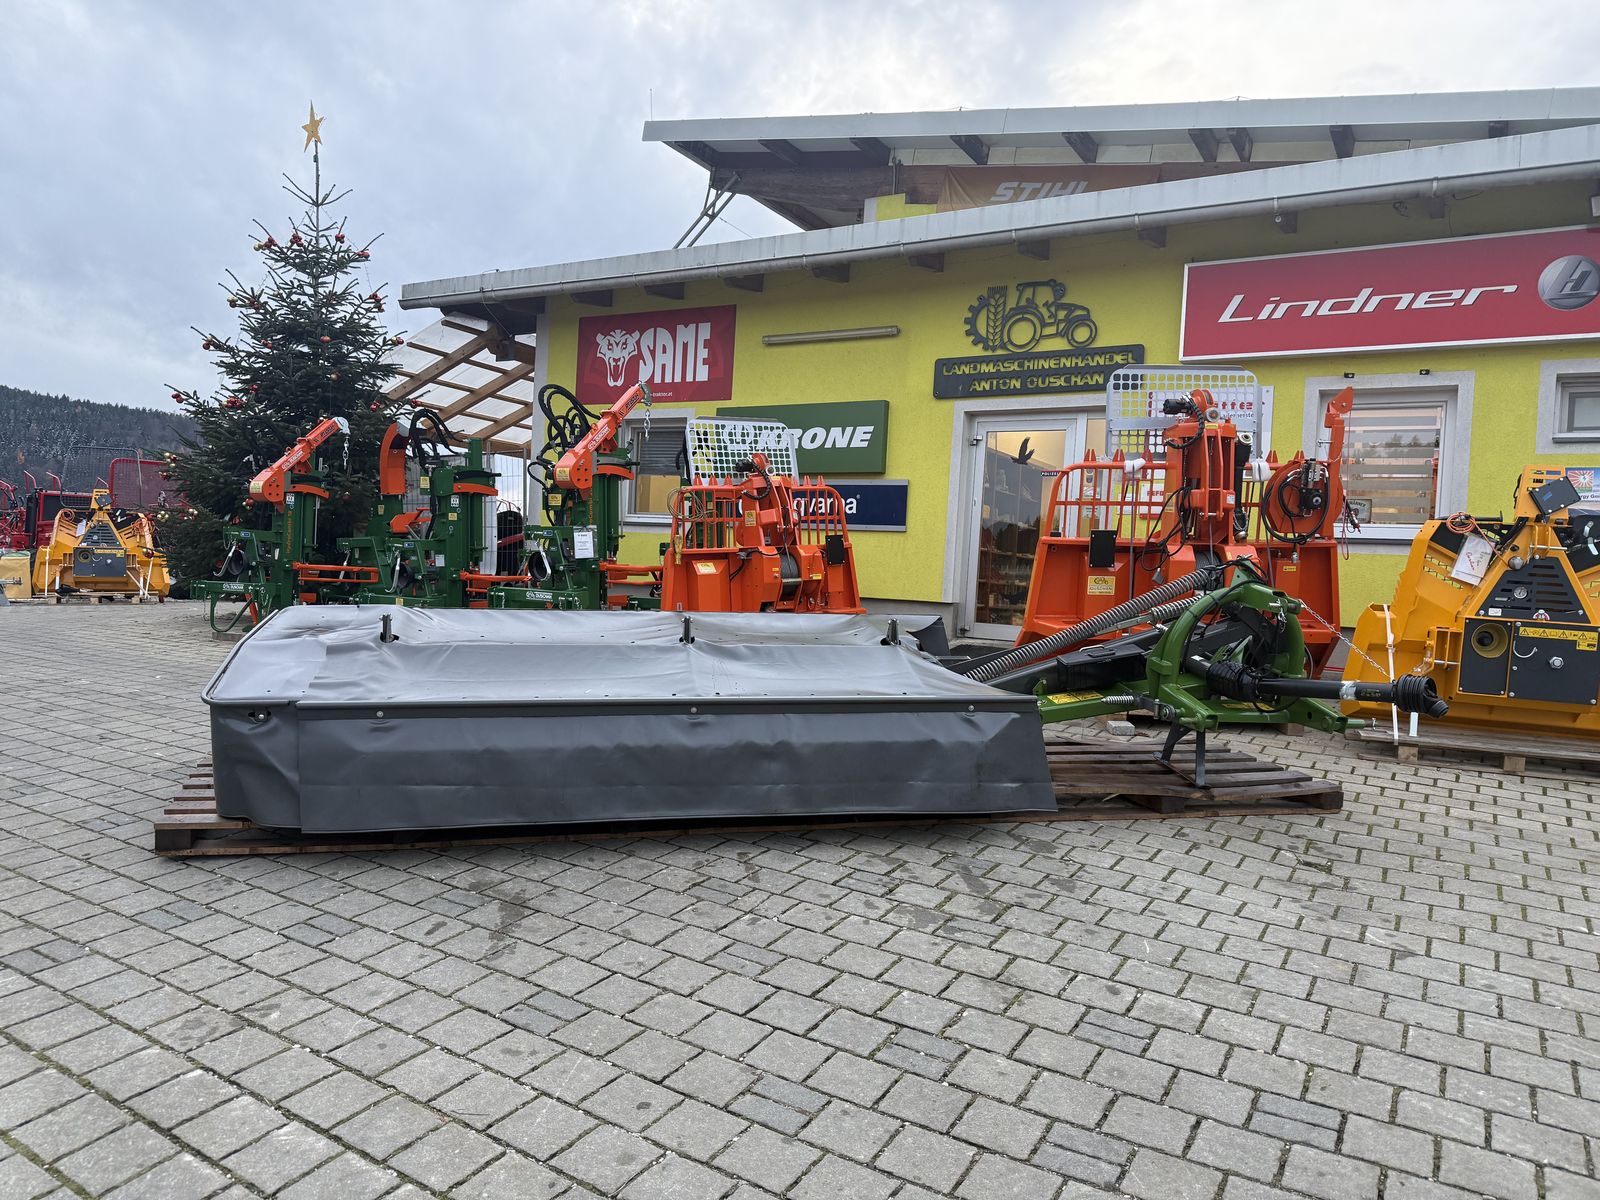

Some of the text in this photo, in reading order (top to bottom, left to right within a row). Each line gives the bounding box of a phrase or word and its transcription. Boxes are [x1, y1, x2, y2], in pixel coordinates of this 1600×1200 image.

[1218, 284, 1518, 323] Lindner
[639, 322, 711, 384] SAME
[943, 352, 1137, 376] LANDMASCHINENHANDEL
[969, 373, 1105, 392] ANTON OUSCHAN
